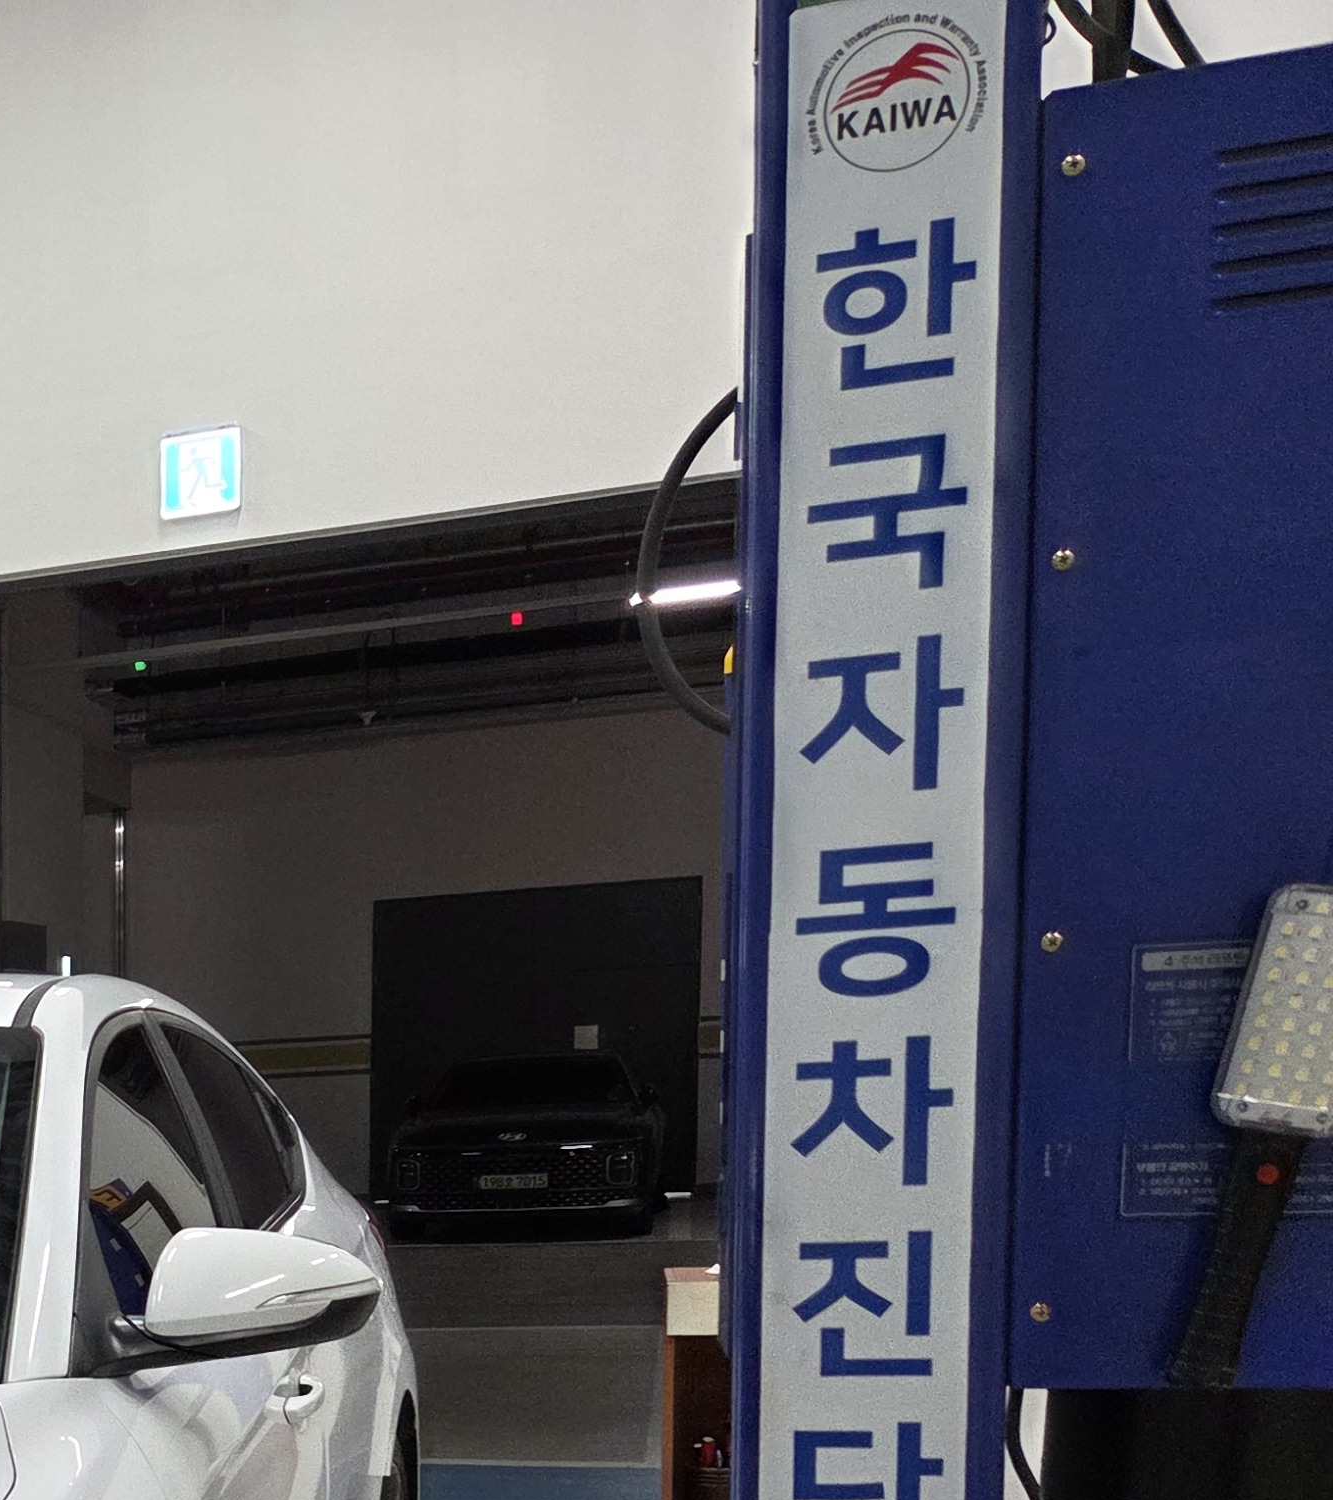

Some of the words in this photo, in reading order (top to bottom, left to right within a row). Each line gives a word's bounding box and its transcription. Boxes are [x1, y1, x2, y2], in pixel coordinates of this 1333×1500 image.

[844, 13, 911, 50] Inspection
[913, 12, 938, 25] and
[939, 16, 981, 58] Warranty
[836, 94, 958, 142] KAIWA
